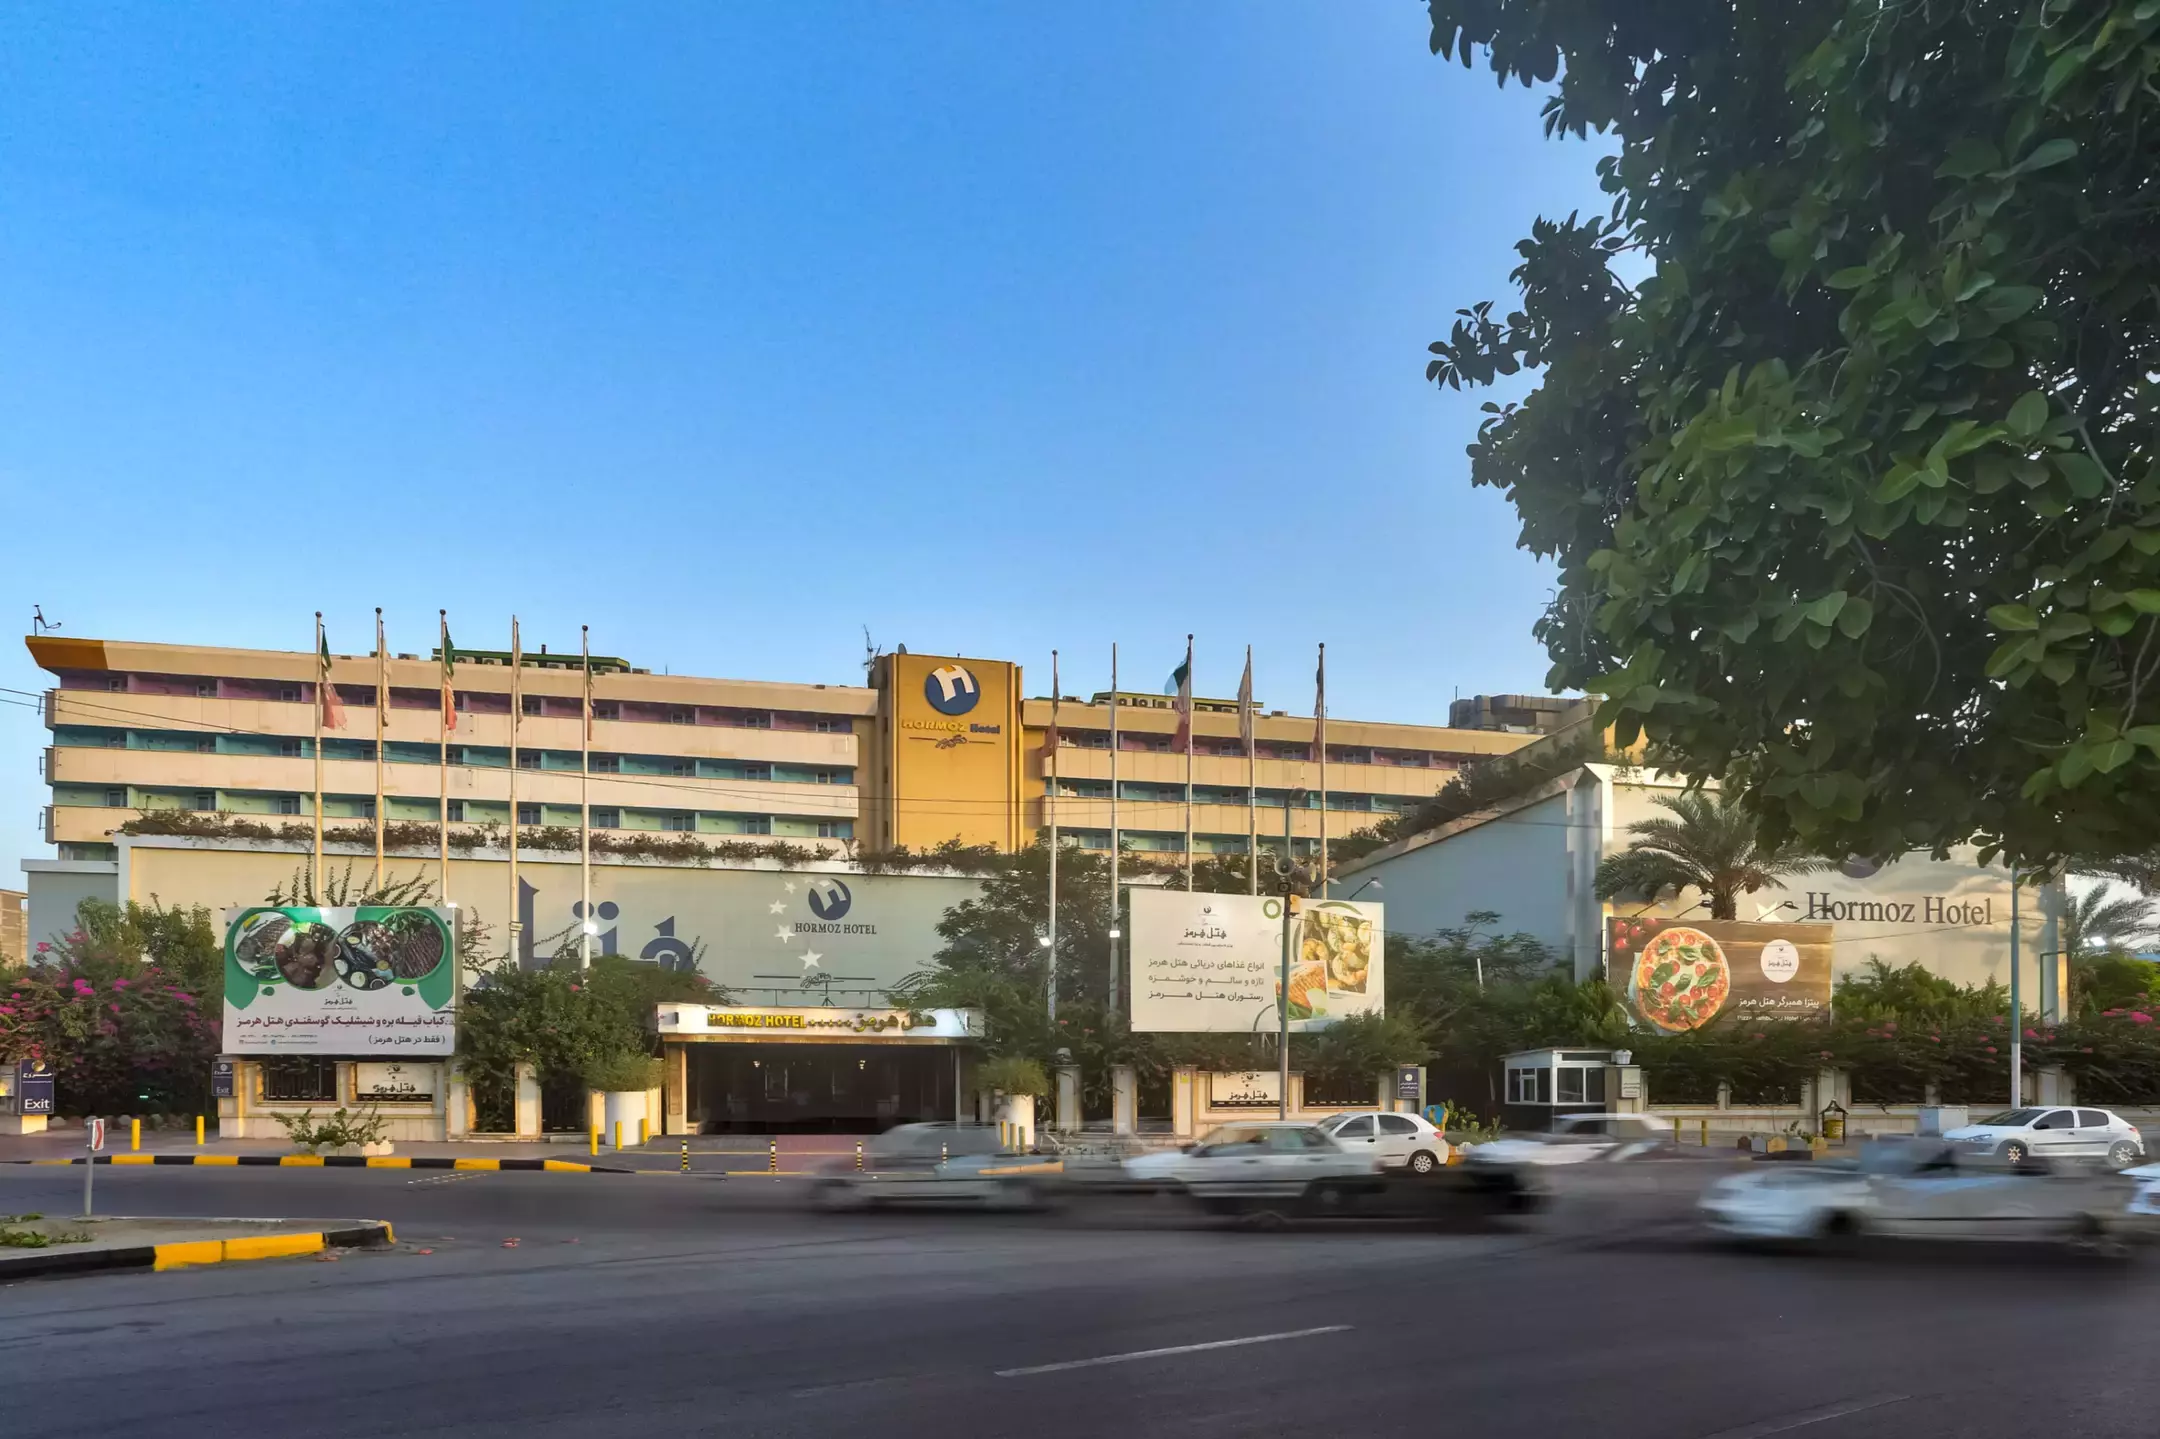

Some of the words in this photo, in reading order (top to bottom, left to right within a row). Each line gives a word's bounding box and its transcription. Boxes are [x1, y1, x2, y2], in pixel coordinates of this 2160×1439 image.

[901, 719, 967, 733] HORMOZ
[1805, 892, 1915, 922] Hormoz
[1923, 896, 1992, 925] Hotel
[795, 922, 841, 933] HORMOZ
[843, 924, 877, 935] HOTEL
[1184, 928, 1206, 938] هرمز
[1206, 927, 1227, 939] هتل
[1148, 958, 1168, 968] هرمز
[1170, 958, 1188, 968] هتل
[1217, 960, 1245, 970] غذاهای
[1247, 962, 1265, 972] انواع
[1251, 977, 1264, 986] تازه
[1738, 997, 1757, 1007] هرمز
[1759, 997, 1775, 1007] هتل
[1777, 995, 1803, 1008] همبرگر
[1804, 997, 1820, 1009] پیتزا
[236, 1016, 262, 1027] هرمز
[263, 1016, 284, 1027] هتل
[376, 1018, 381, 1027] و
[382, 1018, 395, 1027] بره
[423, 1015, 445, 1027] کباب
[707, 1013, 762, 1027] HORMOZ
[765, 1014, 807, 1028] HOTEL
[853, 1012, 898, 1032] هرمز
[394, 1036, 412, 1045] هتل
[412, 1037, 422, 1045] در
[216, 1086, 230, 1094] Exit
[1249, 1090, 1268, 1099] هتل
[1229, 1091, 1249, 1100] هرمز
[24, 1098, 50, 1109] Exit
